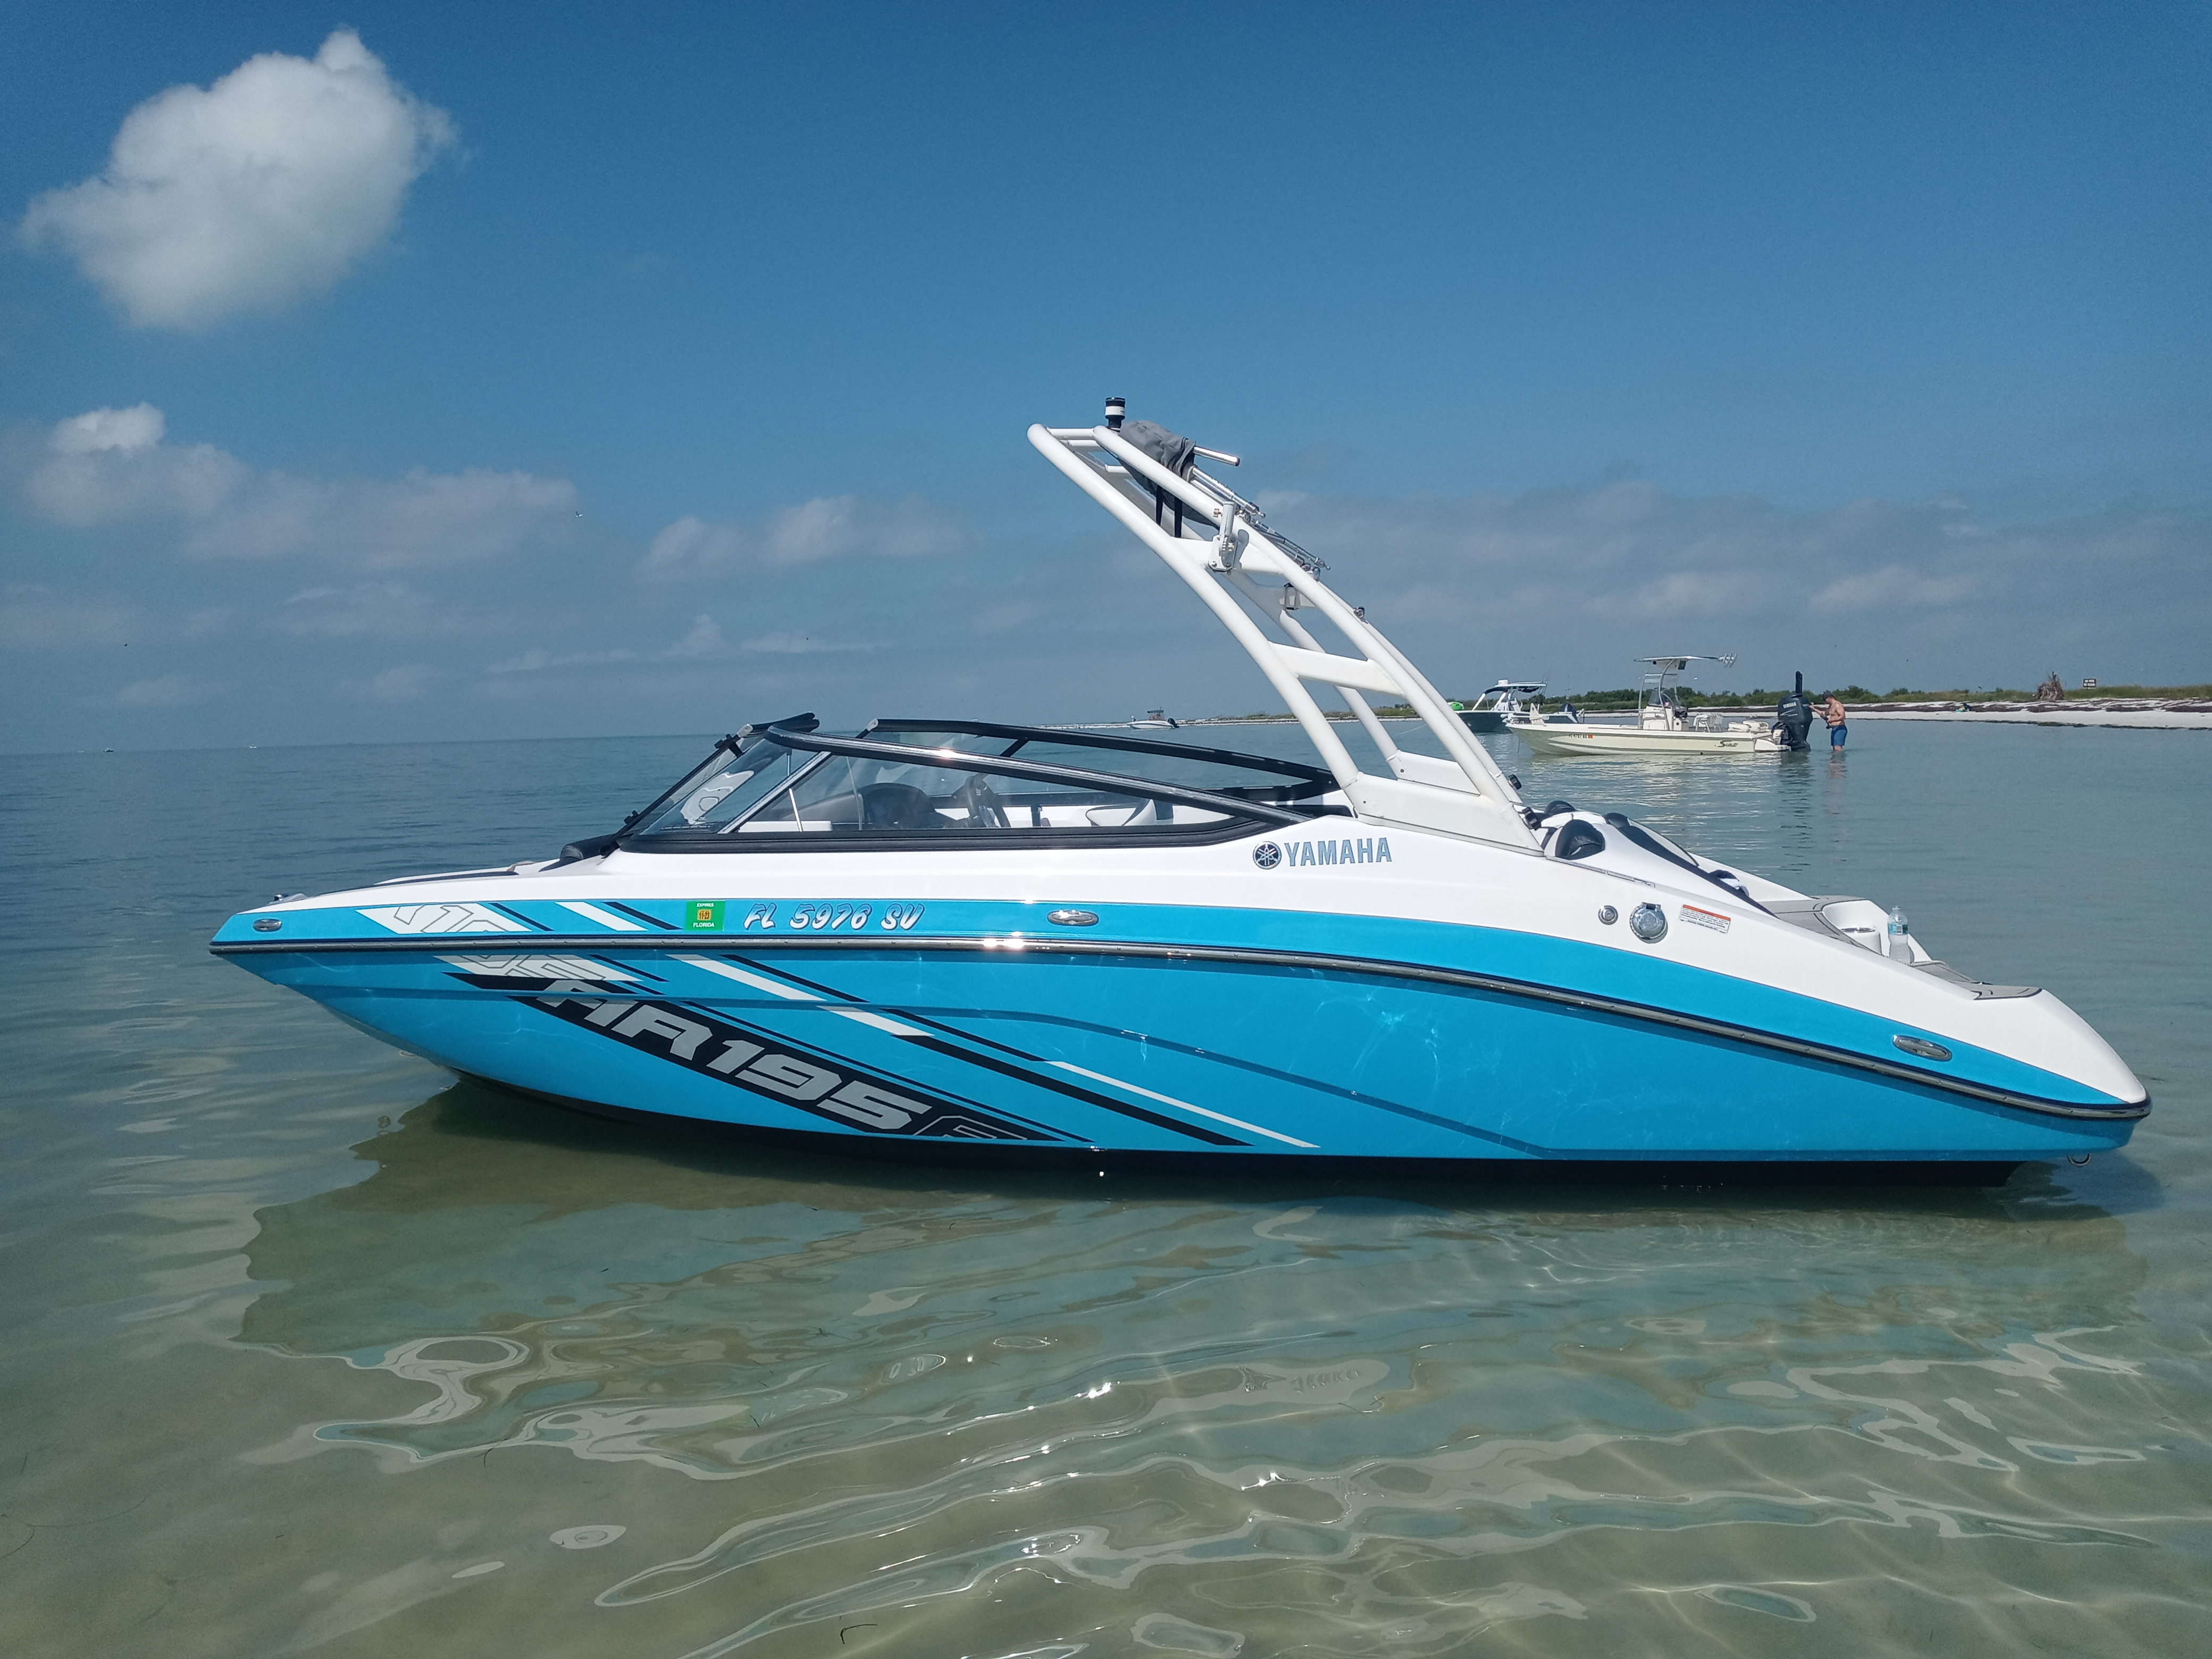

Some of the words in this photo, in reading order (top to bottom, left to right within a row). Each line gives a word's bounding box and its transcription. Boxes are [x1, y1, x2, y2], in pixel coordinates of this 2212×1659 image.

[1284, 837, 1392, 867] YAMAHA
[743, 902, 777, 931] FL
[789, 903, 873, 931] 5976
[536, 979, 933, 1129] AR195
